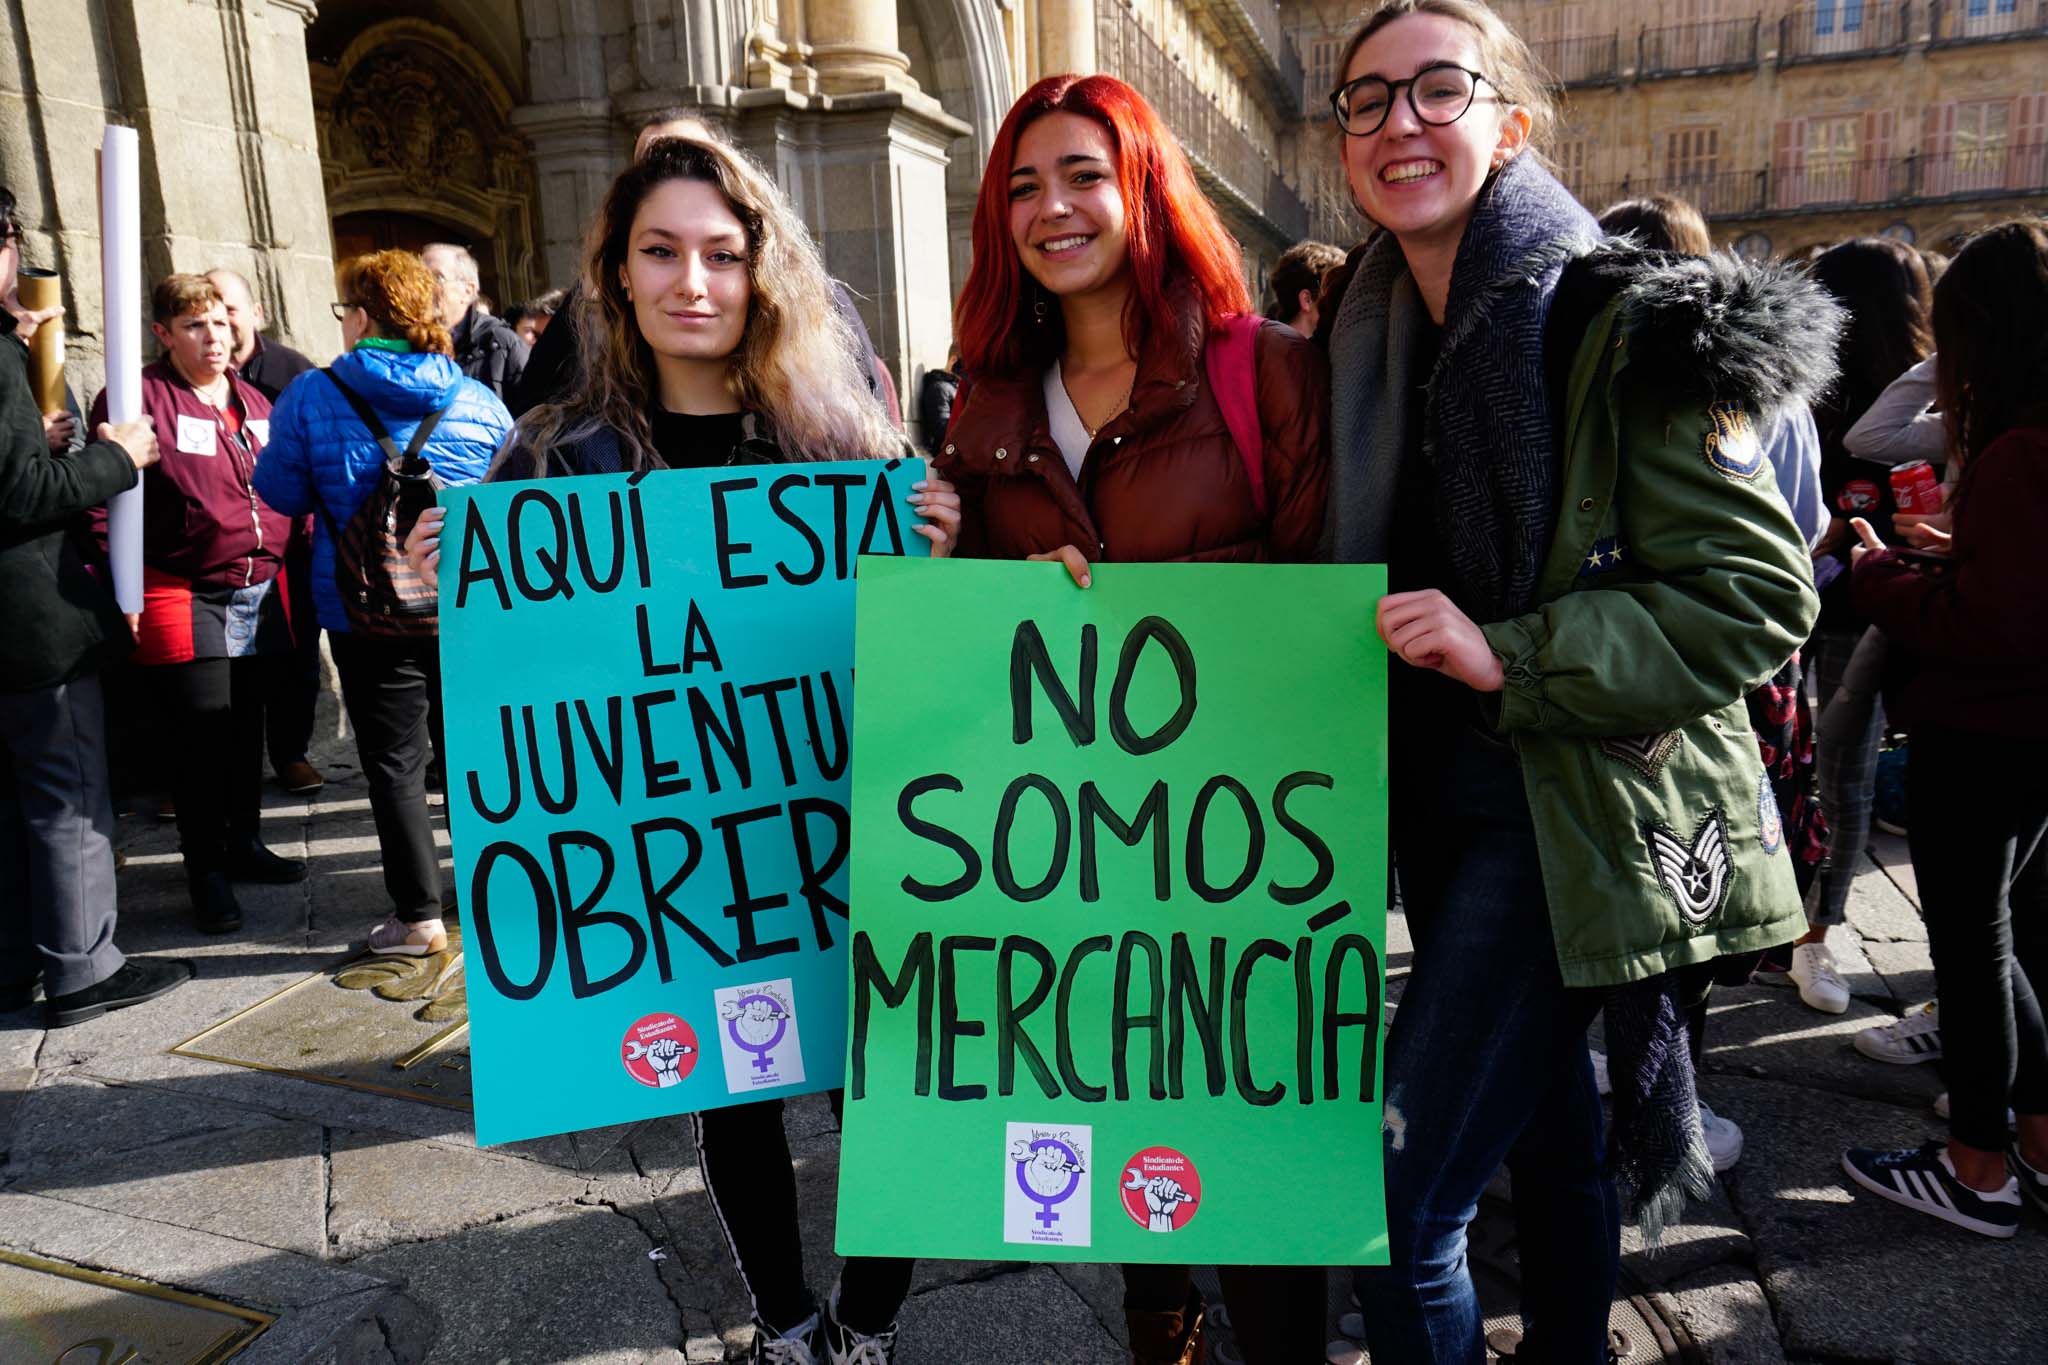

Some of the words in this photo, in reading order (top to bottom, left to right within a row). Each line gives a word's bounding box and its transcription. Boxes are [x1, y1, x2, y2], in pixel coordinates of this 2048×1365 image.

[457, 468, 651, 610] AQUÍ
[711, 459, 906, 589] ESTÁ
[636, 599, 722, 677] LA
[1010, 616, 1197, 757] NO
[466, 668, 855, 824] JUVENTU
[898, 771, 1334, 905] SOMOS
[852, 901, 1380, 1106] MERCANCÍA
[1144, 1164, 1184, 1172] Estudiantes
